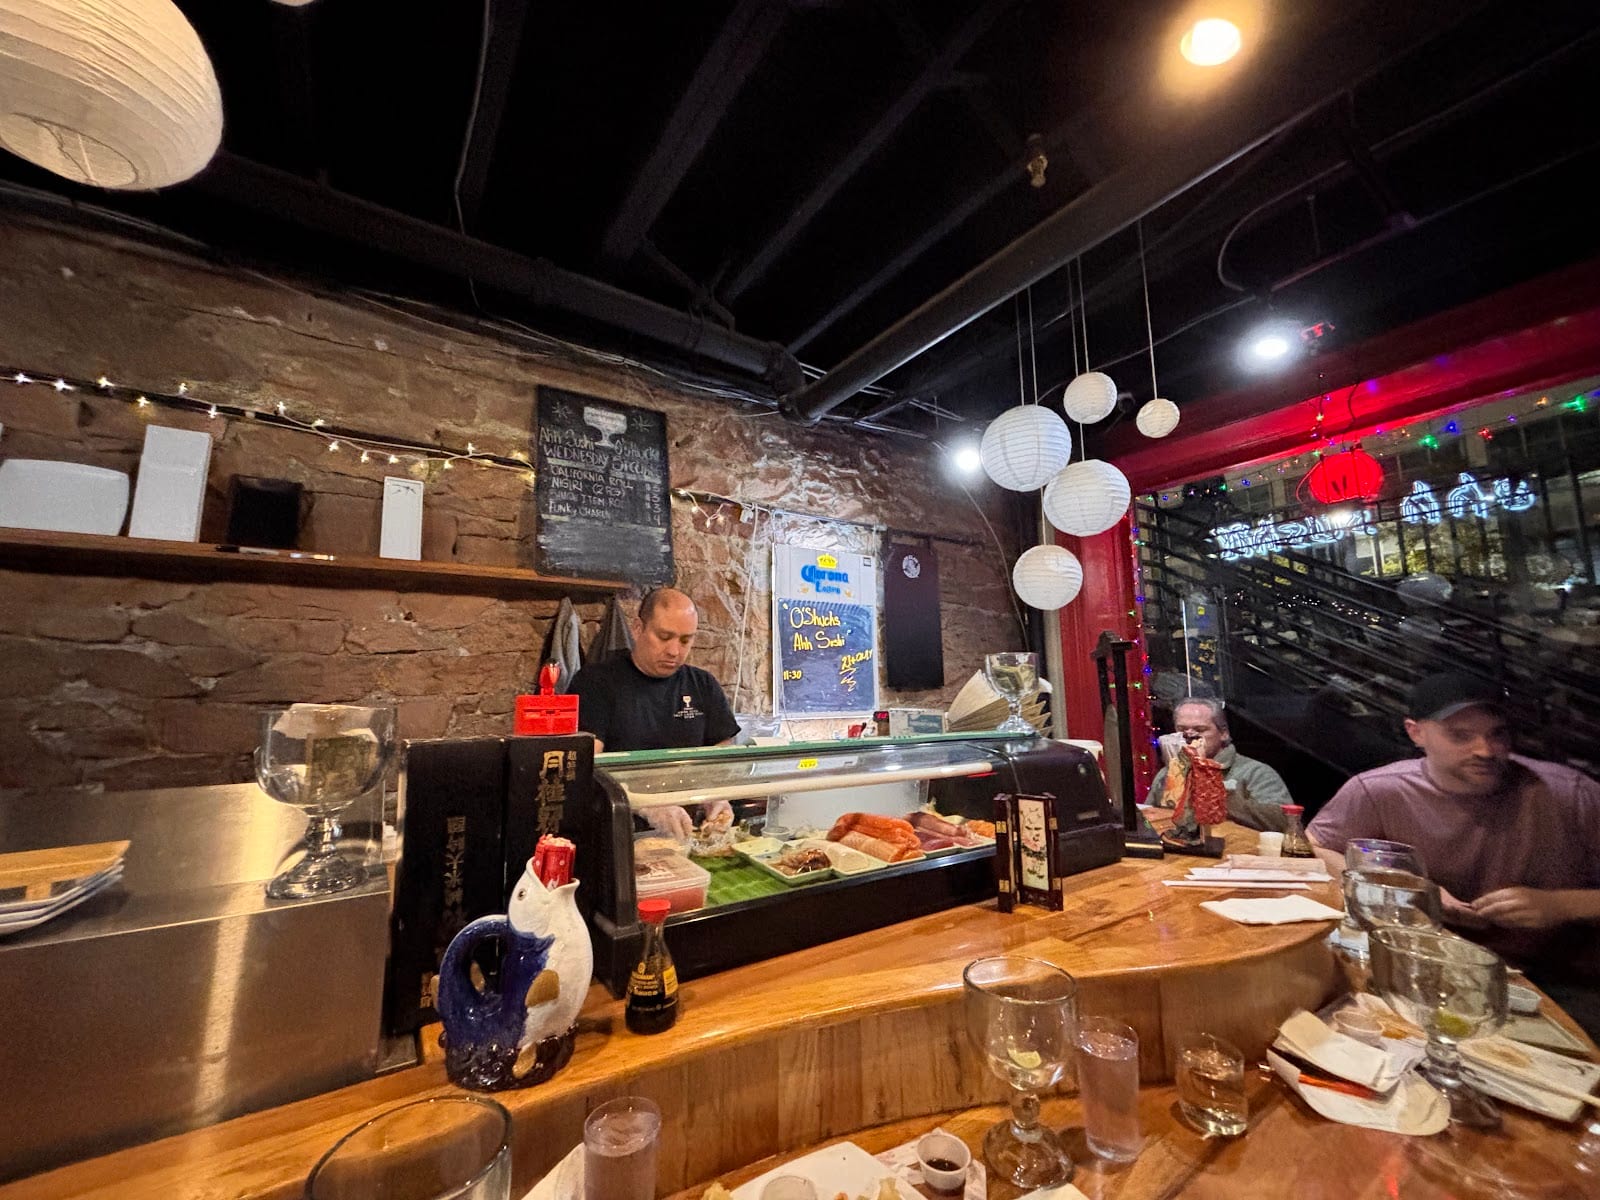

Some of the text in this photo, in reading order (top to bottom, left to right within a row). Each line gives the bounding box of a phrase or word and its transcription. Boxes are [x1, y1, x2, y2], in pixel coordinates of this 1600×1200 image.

[543, 444, 610, 470] WEDNESDAY
[550, 464, 606, 483] CALIFORNIA
[551, 475, 583, 492] NIGIRI
[800, 564, 850, 584] Corona
[789, 606, 842, 629] O'Shucks
[793, 630, 846, 652] Ahh Sushi
[782, 669, 803, 681] 11:30
